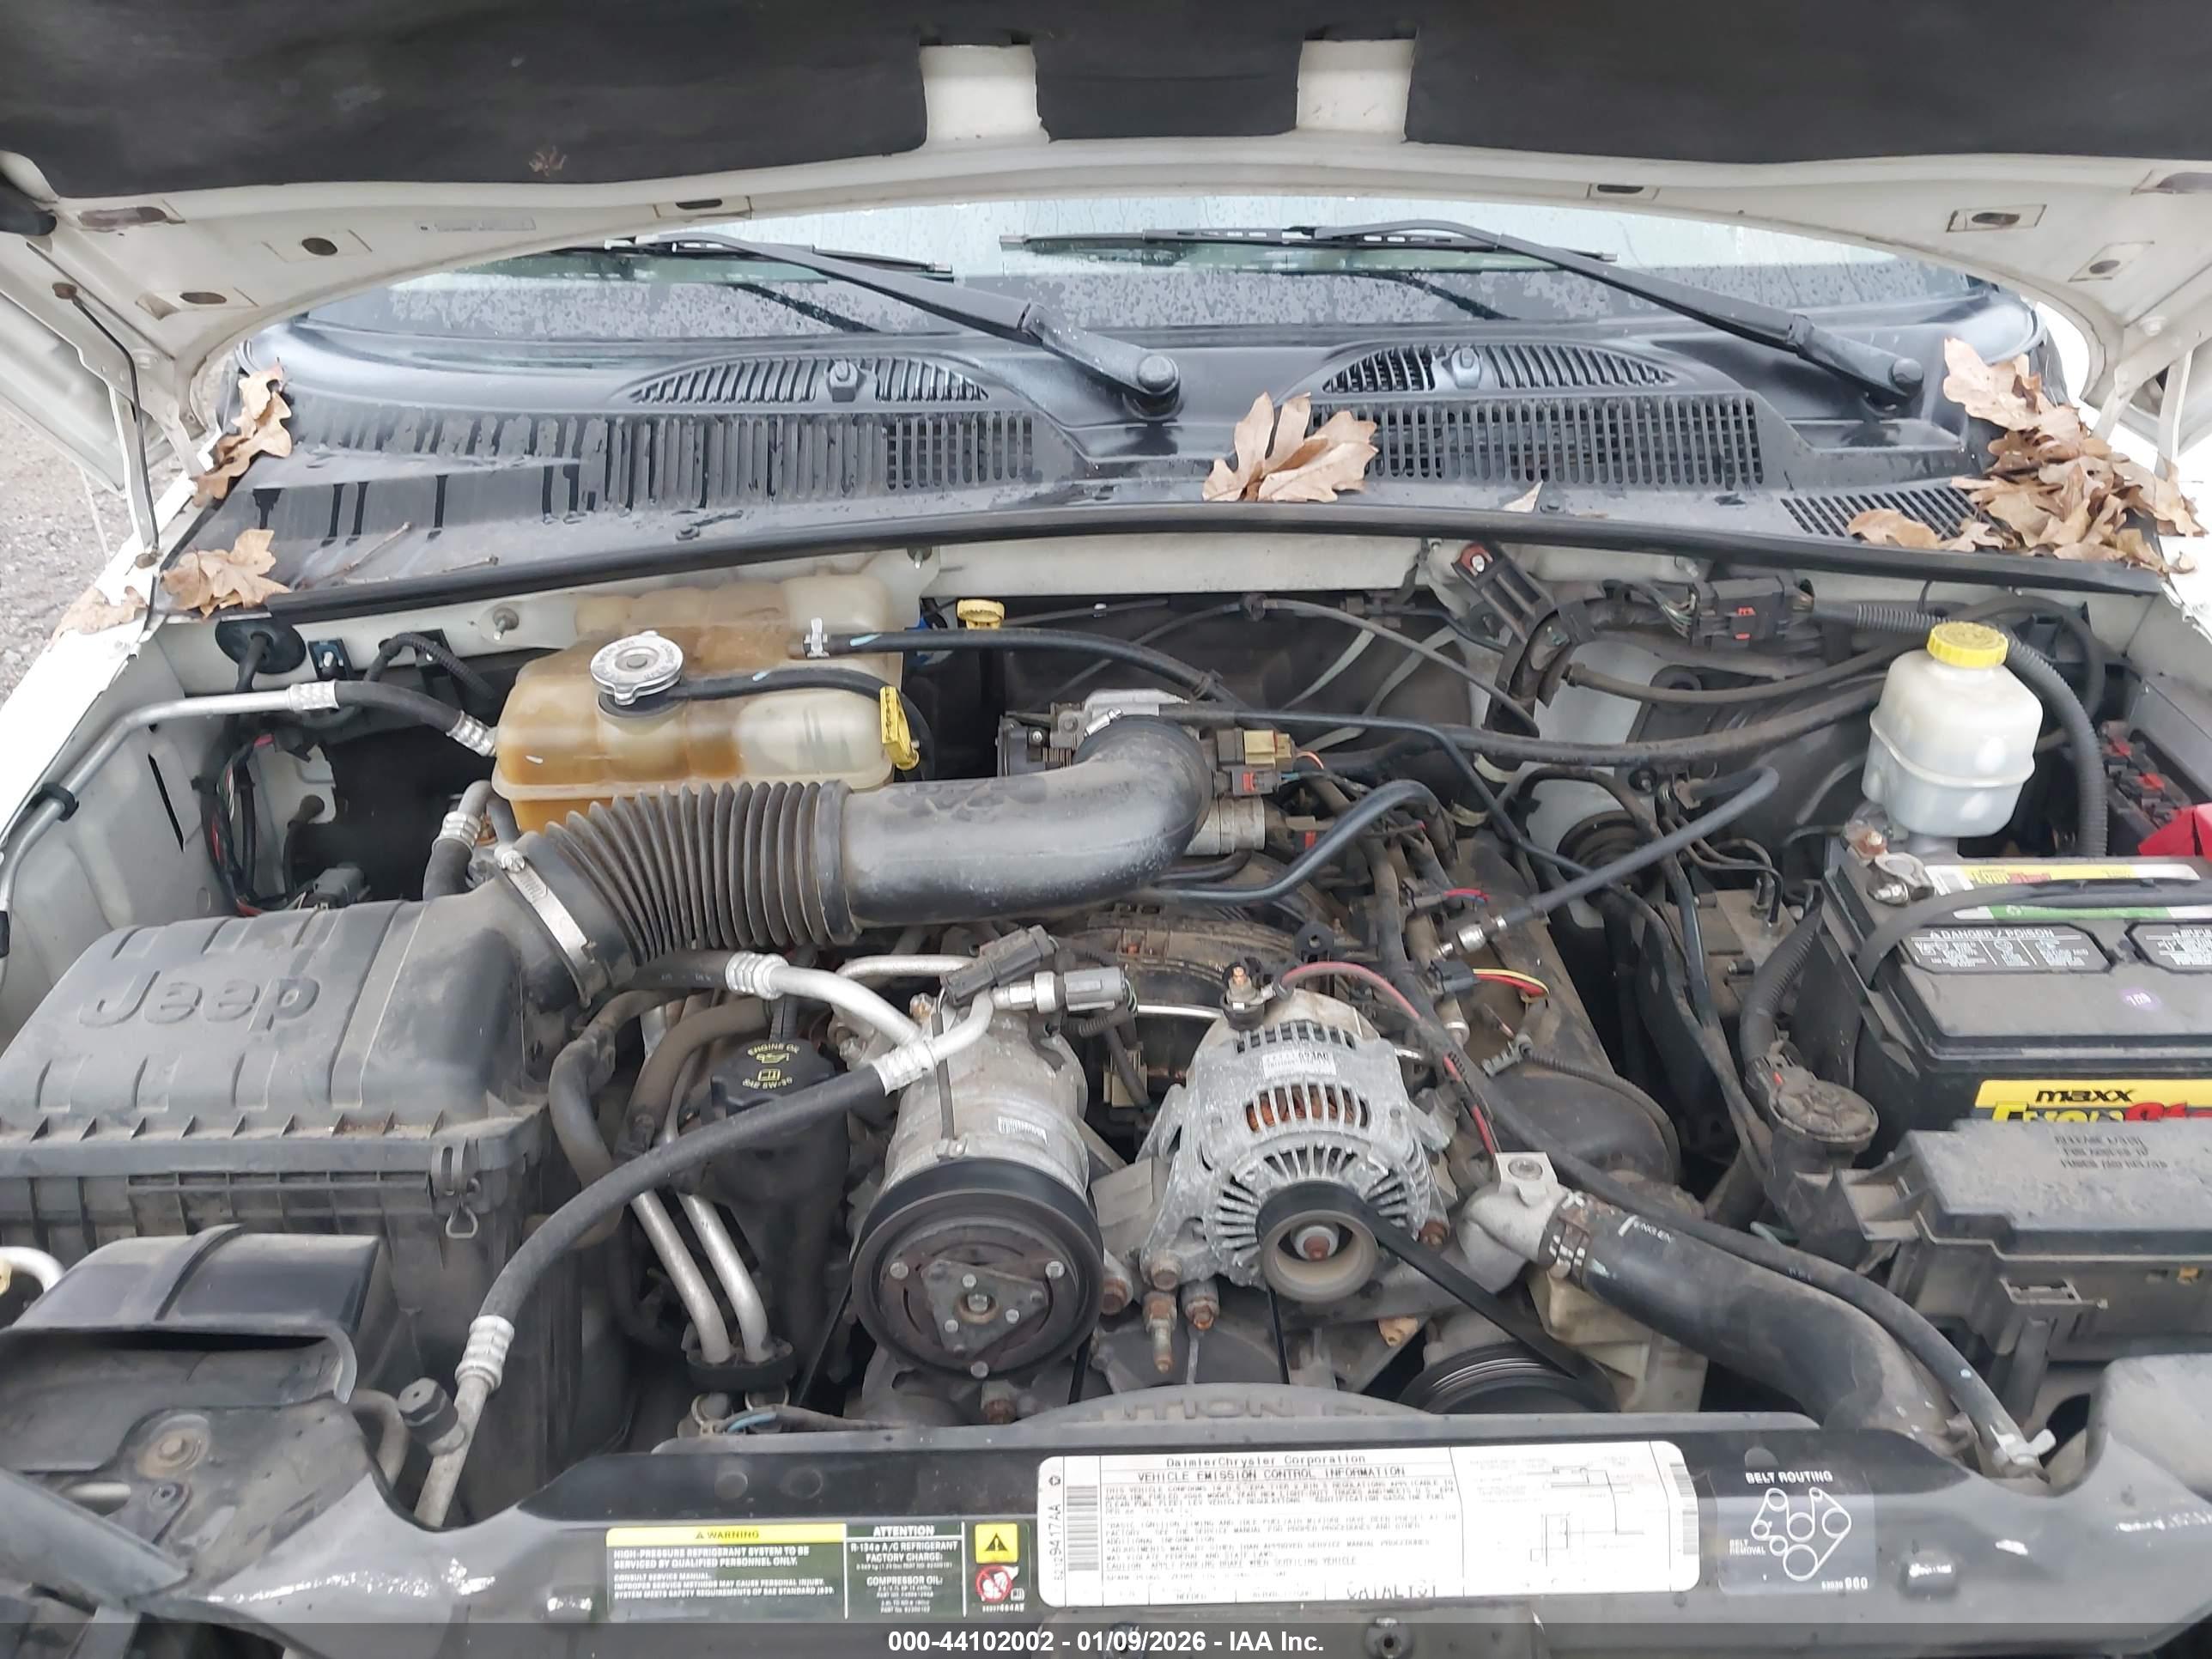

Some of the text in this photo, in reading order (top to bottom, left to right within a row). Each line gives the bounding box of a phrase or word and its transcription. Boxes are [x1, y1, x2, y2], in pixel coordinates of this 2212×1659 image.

[77, 969, 321, 1033] Jeep
[2035, 1089, 2136, 1103] maxx
[1166, 1453, 1366, 1468] DaimlerChrysler Corporation
[1138, 1466, 1406, 1482] VEHICLE EMISSION CONTROL INFORMATION
[1745, 1470, 1834, 1485] BELT ROUTING
[707, 1530, 759, 1540] WARNING
[872, 1524, 935, 1537] ATTENTION
[687, 1547, 746, 1559] REFRIGERANT
[748, 1546, 783, 1557] SYSTEM
[783, 1546, 797, 1556] TO
[881, 1542, 899, 1553] A/C
[899, 1540, 958, 1552] REFRIGERANT
[613, 1559, 657, 1570] SERVICED
[658, 1559, 671, 1569] BY
[671, 1558, 718, 1569] QUALIFIED
[719, 1557, 772, 1568] PERSONNEL
[866, 1553, 905, 1563] FACTORY
[719, 1580, 735, 1589] MAY
[760, 1578, 798, 1588] PERSONAL
[866, 1575, 925, 1587] COMPRESSOR
[778, 1586, 816, 1595] STANDARD
